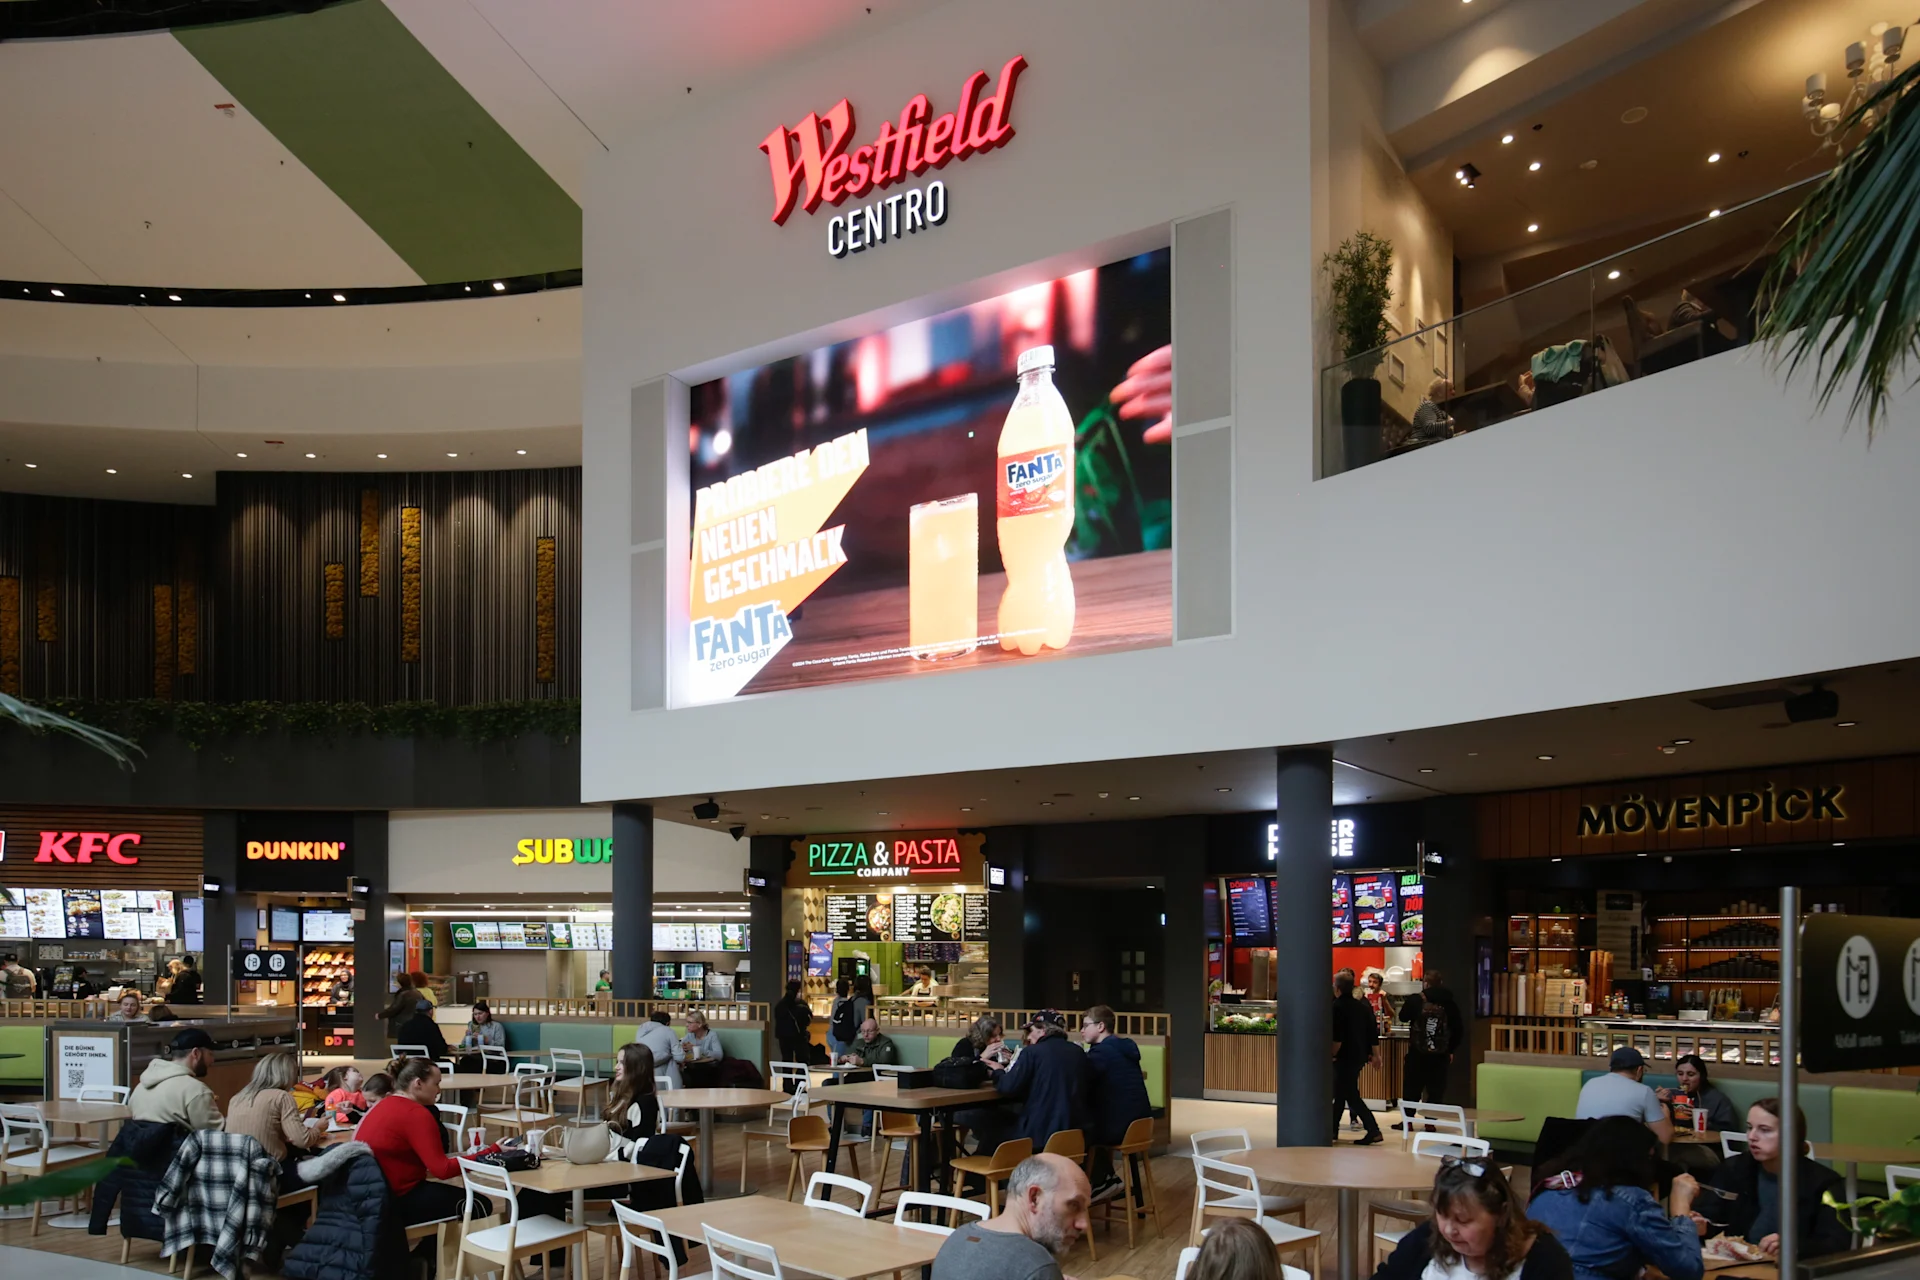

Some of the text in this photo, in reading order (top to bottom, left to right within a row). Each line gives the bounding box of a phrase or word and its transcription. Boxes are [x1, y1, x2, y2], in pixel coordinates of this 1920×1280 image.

[758, 54, 1028, 227] Westfield
[828, 180, 948, 259] CENTRO
[696, 427, 870, 524] PROBIERE DEN
[1007, 453, 1063, 484] FANTA
[700, 505, 777, 565] NEUEN
[703, 524, 848, 604] GESCHMACK
[694, 603, 789, 662] FANTA
[709, 646, 772, 673] zero sugar
[33, 831, 142, 865] KFC
[247, 841, 346, 861] DUNKIN'
[511, 838, 613, 866] SUBW
[809, 838, 960, 868] PIZZA & PASTA
[856, 867, 910, 878] COMPANY
[1400, 885, 1424, 896] CHICKE
[324, 1036, 343, 1047] DD
